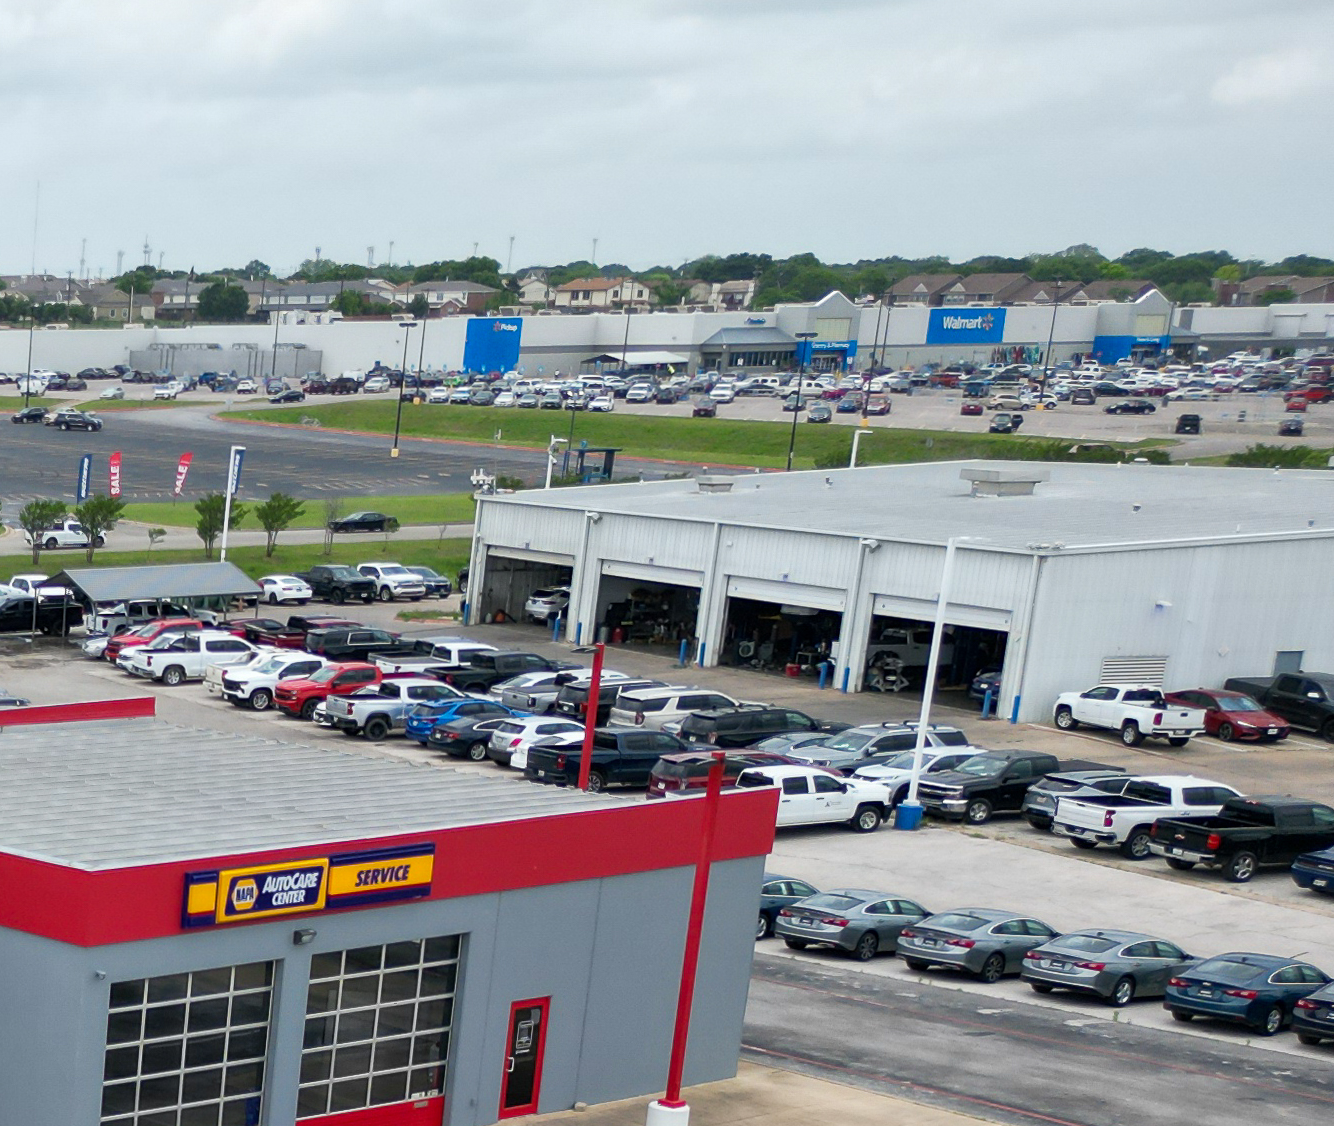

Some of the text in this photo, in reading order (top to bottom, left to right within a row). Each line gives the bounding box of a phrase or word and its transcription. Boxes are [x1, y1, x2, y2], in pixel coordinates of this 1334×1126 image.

[943, 316, 982, 329] Walmart
[111, 465, 120, 495] SALE
[175, 464, 189, 494] SALE
[355, 864, 411, 887] SERVICE
[235, 885, 255, 903] NAPA
[272, 889, 306, 906] CENTER
